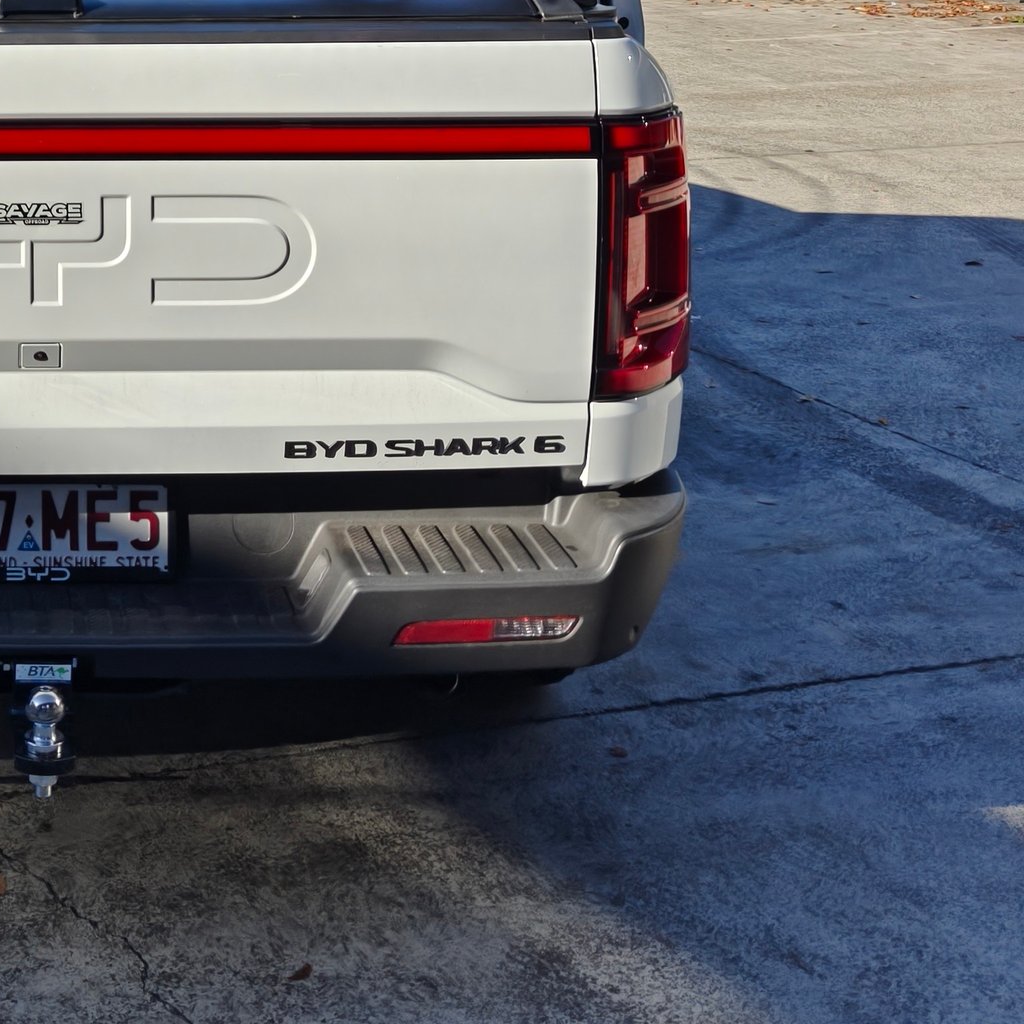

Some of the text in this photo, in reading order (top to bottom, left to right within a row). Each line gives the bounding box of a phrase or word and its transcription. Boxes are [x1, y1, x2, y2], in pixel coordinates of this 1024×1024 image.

[284, 435, 566, 459] BYD SHARK 6
[23, 541, 35, 549] EV
[33, 556, 107, 568] SUNSHINE
[116, 556, 160, 568] STATE
[5, 567, 71, 581] BYD
[27, 665, 55, 677] BTA
